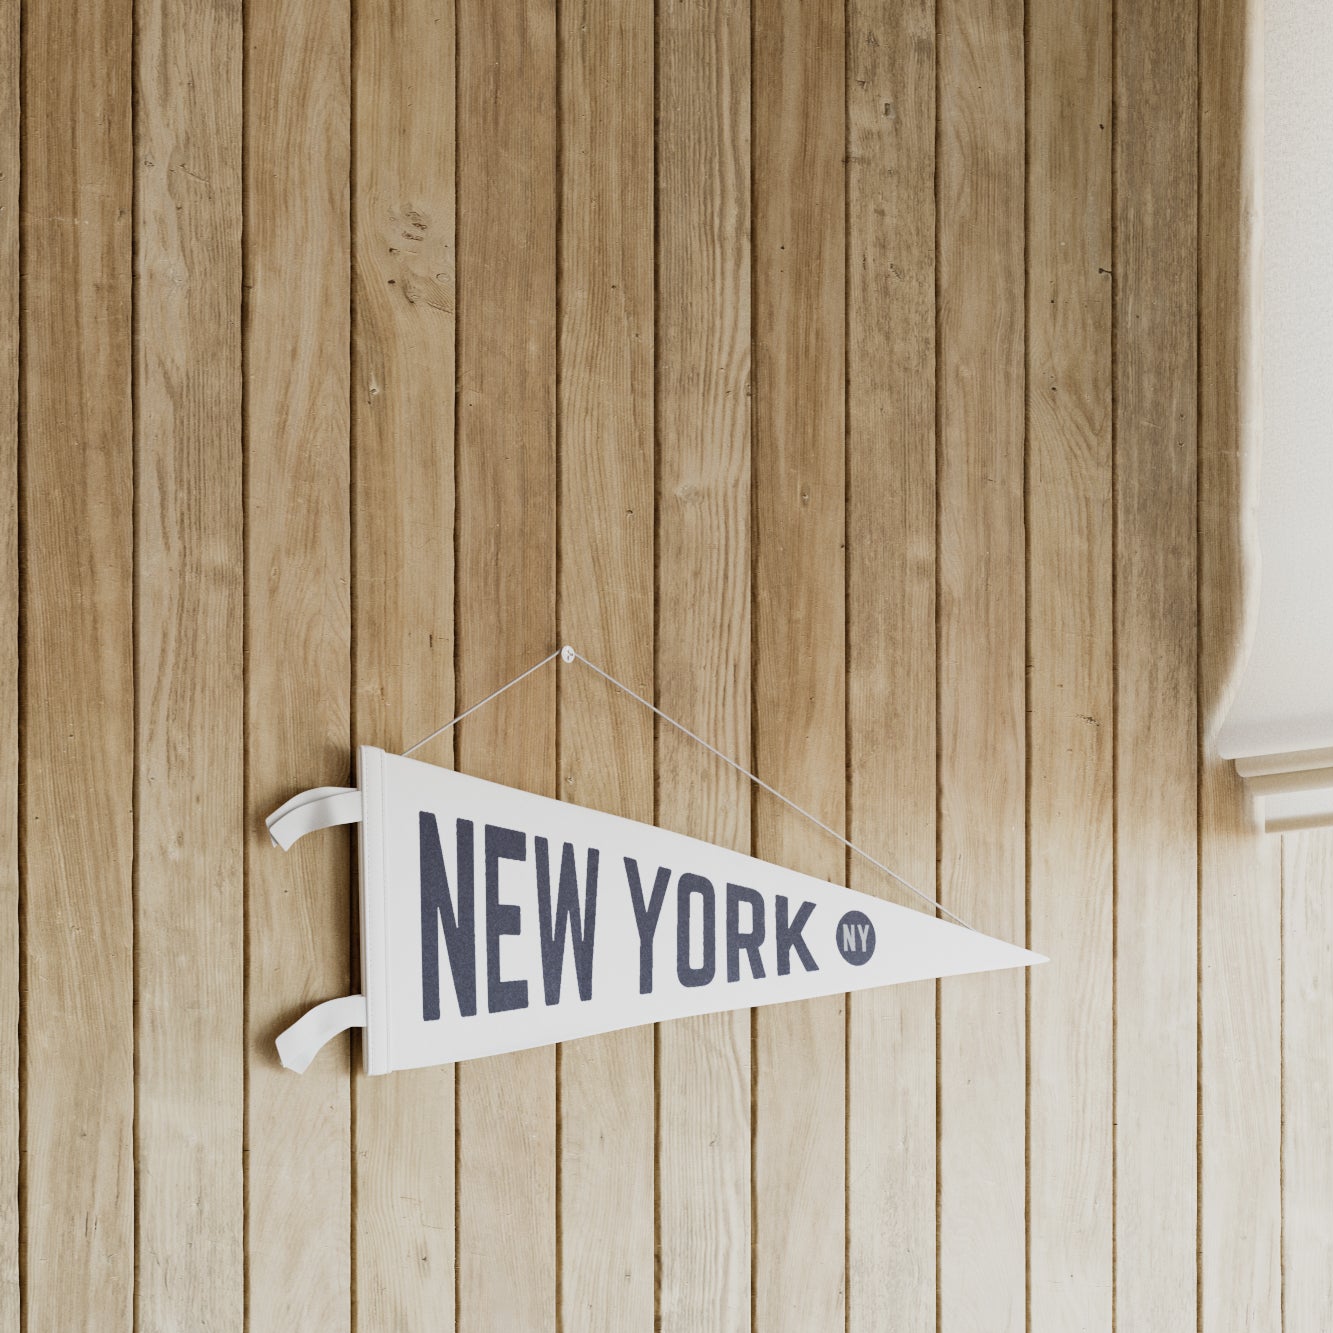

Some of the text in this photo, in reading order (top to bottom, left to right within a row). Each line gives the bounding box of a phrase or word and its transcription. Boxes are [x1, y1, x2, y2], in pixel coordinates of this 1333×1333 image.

[419, 810, 870, 1021] NEW YORK NY
